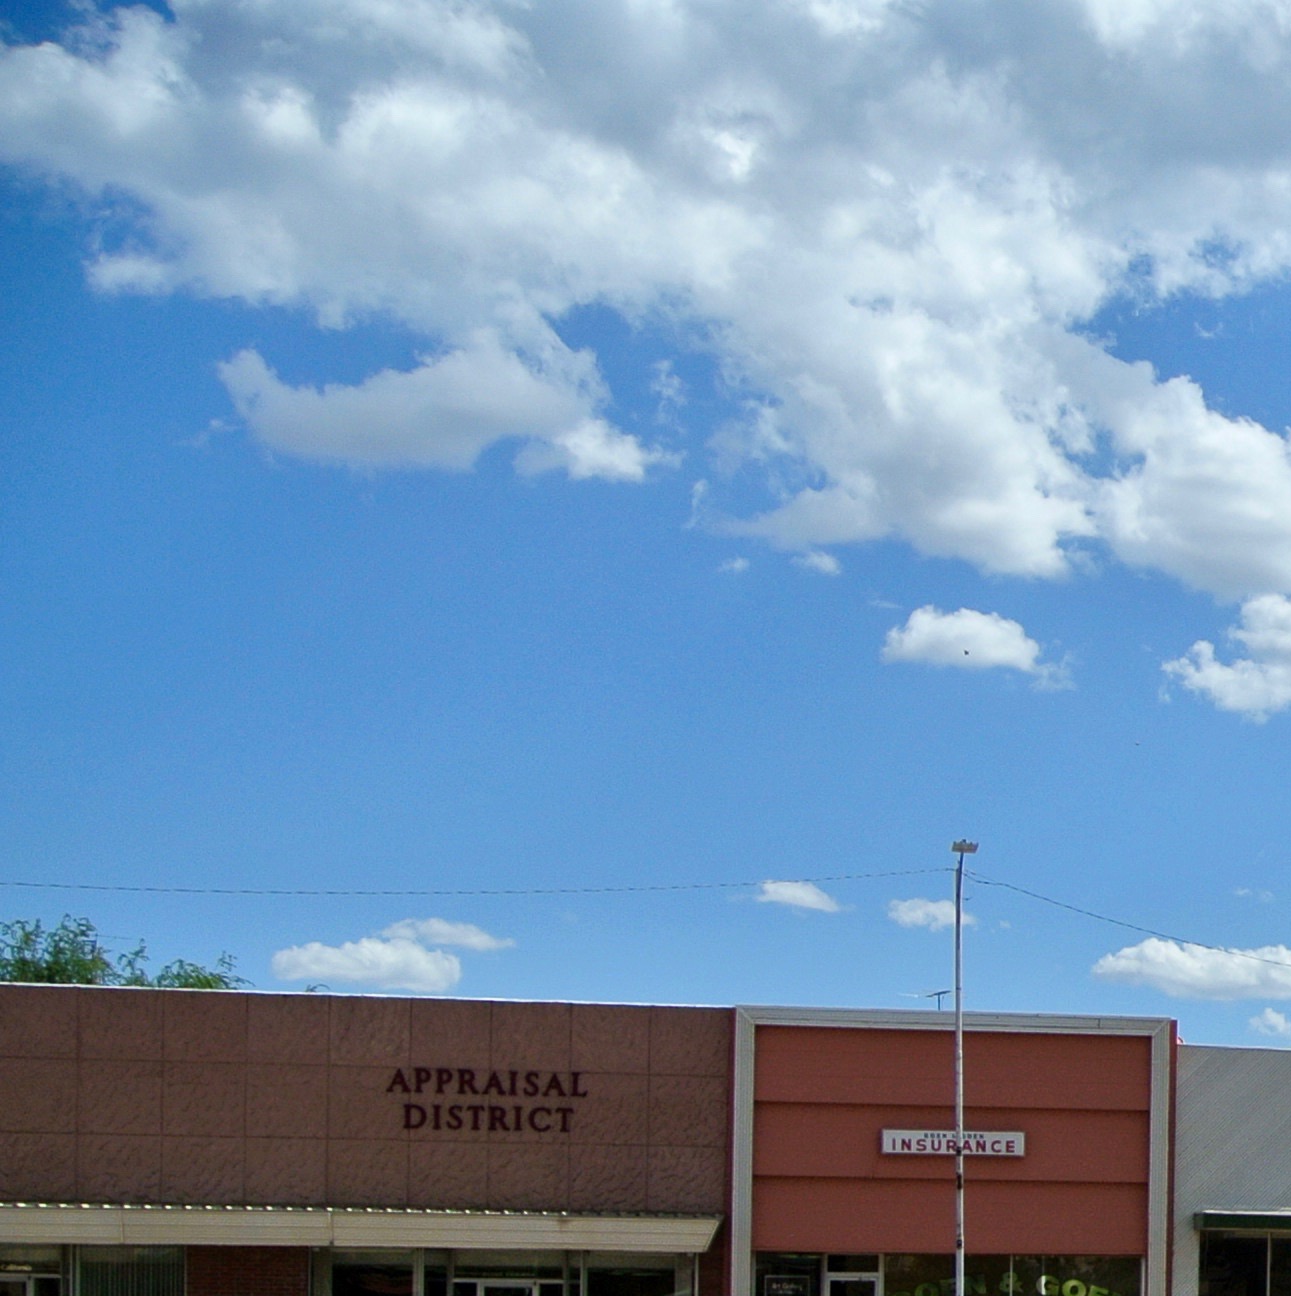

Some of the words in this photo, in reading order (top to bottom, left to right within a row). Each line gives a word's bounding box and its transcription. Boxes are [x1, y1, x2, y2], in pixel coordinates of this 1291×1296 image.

[386, 1067, 588, 1097] APPRAISAL
[403, 1104, 574, 1133] DISTRICT
[892, 1138, 1015, 1153] INSURANCE
[999, 1272, 1024, 1293] &
